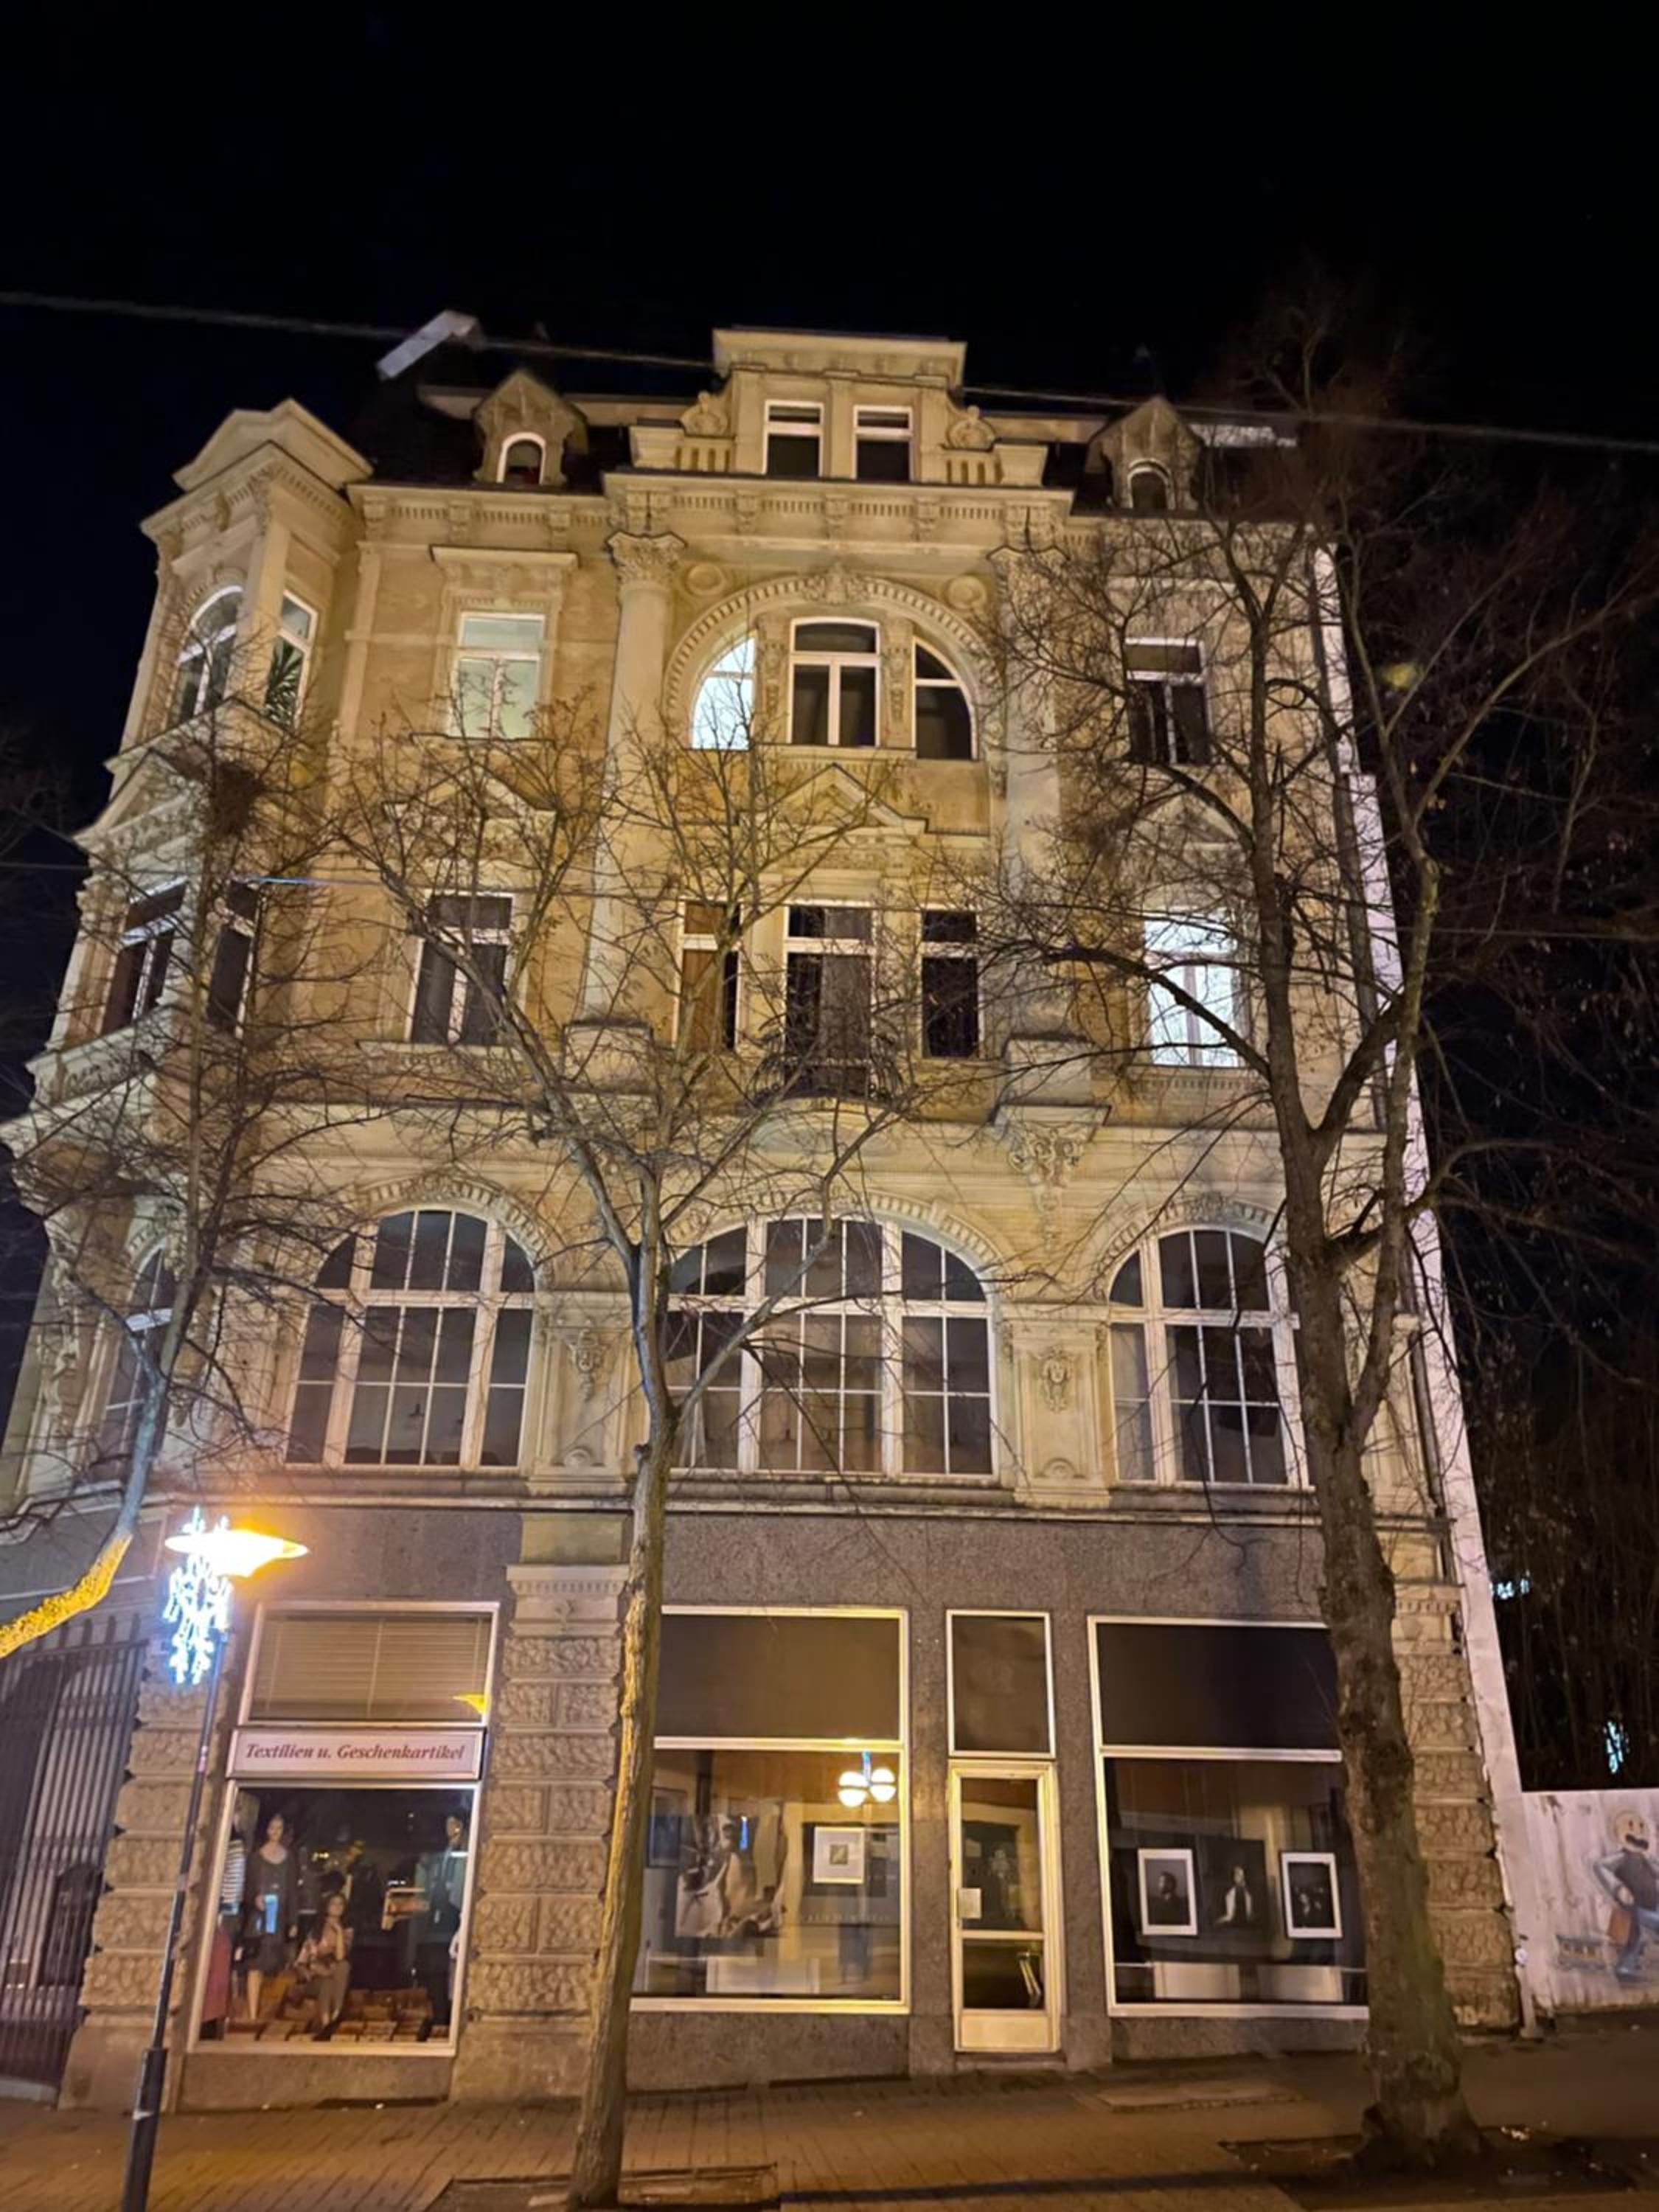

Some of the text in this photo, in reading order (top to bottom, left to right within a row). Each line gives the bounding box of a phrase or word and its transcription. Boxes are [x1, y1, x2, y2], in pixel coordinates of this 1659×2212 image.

[246, 1744, 465, 1759] Textilien u. Geschenkartikel
